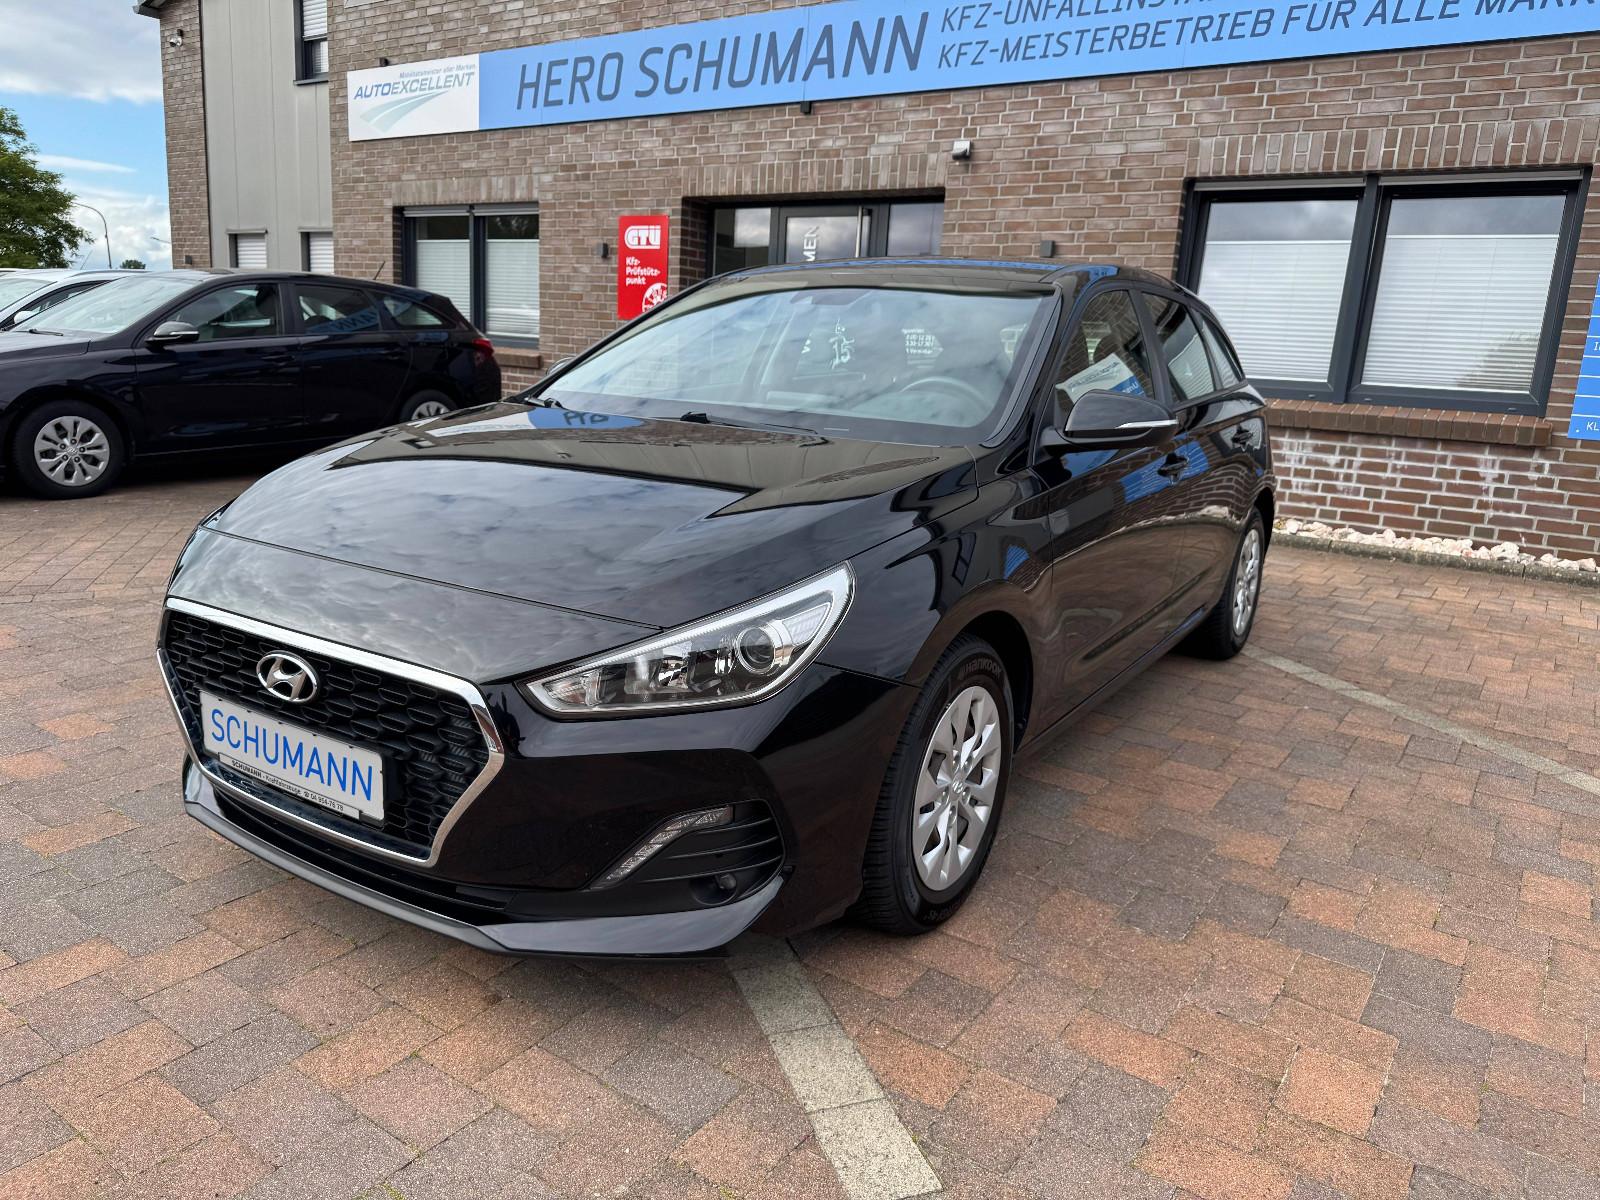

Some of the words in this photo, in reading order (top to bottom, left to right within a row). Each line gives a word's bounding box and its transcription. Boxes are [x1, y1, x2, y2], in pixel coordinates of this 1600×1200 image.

[941, 0, 1213, 32] KFZ-UNFALLI
[937, 8, 1275, 69] KFZ-MEISTERBETRIEB
[1281, 0, 1356, 35] FÜR
[1362, 0, 1460, 26] ALLE
[516, 51, 624, 110] HERO
[634, 12, 930, 99] SCHUMANN
[353, 72, 475, 100] AUTOEXCELLENT
[625, 256, 641, 266] Kfz-
[625, 266, 661, 277] Prüfstütz-
[625, 276, 647, 287] punkt
[211, 708, 372, 801] SCHUMANN
[231, 759, 262, 779] SCHUMANN
